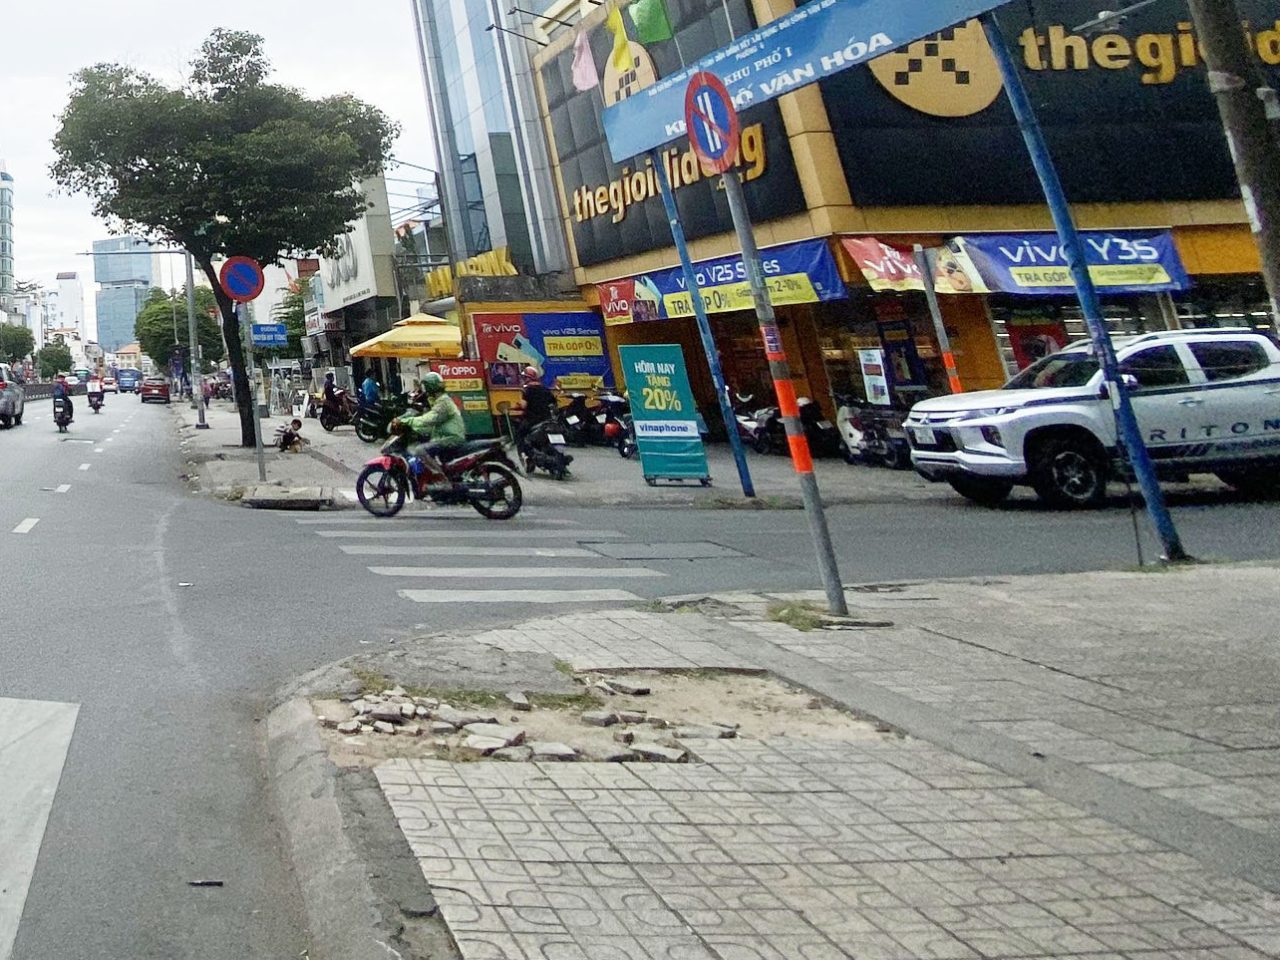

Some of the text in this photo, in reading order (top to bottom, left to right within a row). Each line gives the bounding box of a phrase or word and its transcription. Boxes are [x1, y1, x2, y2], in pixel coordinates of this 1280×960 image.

[724, 66, 750, 86] KHU
[753, 46, 782, 71] PHỐ
[760, 64, 815, 96] VĂN
[821, 33, 893, 71] HÓA
[1087, 238, 1159, 261] Y35
[705, 264, 734, 283] V25
[451, 366, 477, 376] OPPO
[634, 359, 675, 375] HÔM NAY
[642, 387, 682, 412] 20%
[639, 423, 689, 435] vinaphone
